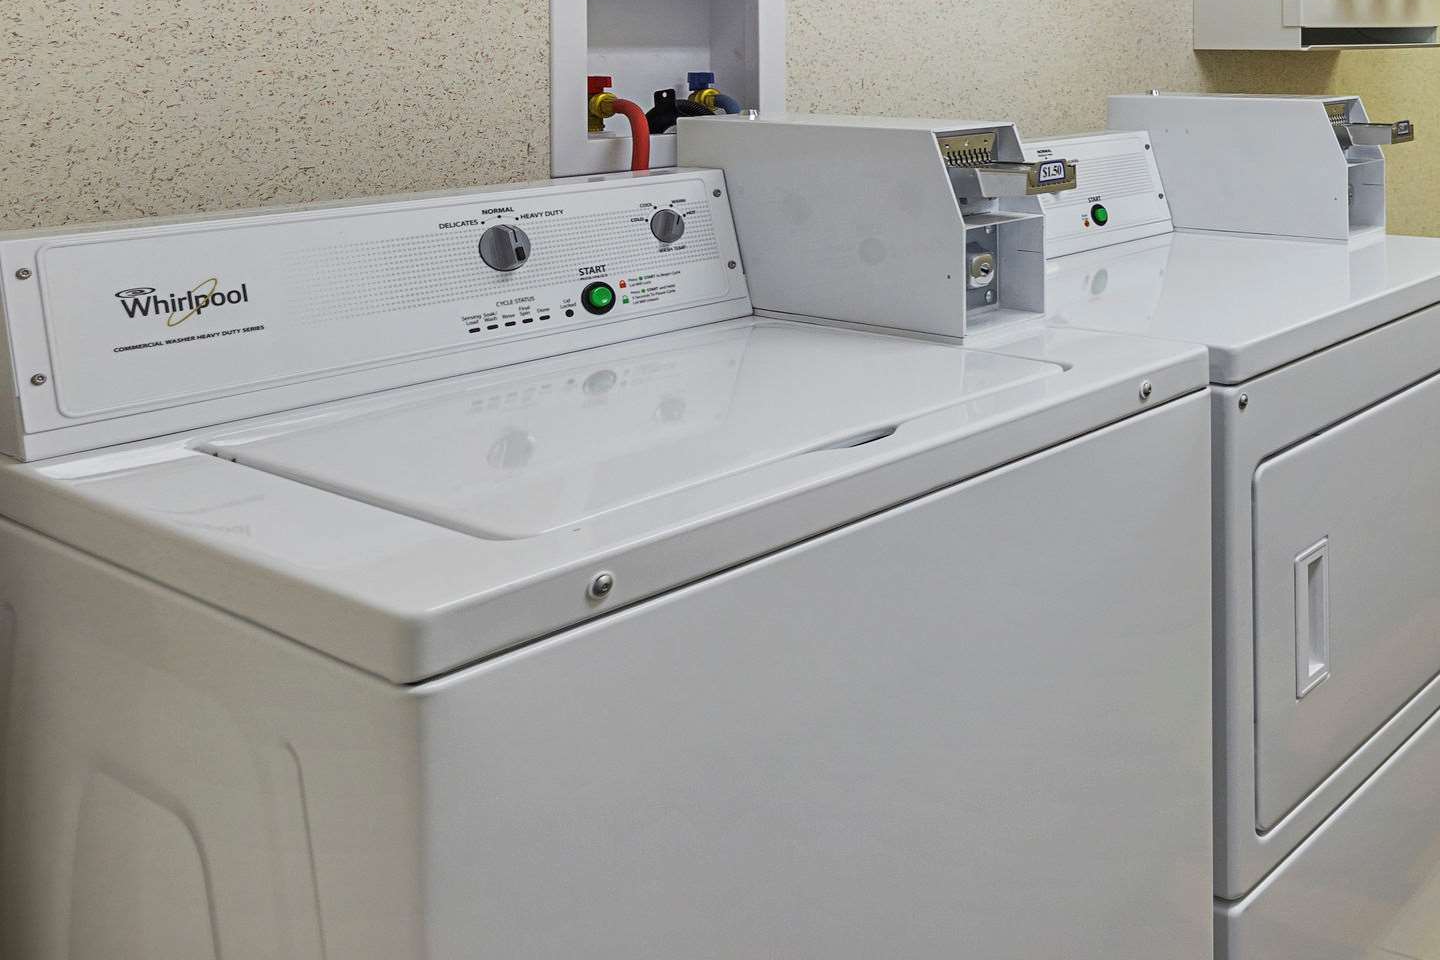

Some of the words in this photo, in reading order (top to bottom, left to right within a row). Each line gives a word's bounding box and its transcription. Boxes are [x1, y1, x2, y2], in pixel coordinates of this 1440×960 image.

[1042, 165, 1062, 178] $1.50
[1088, 195, 1102, 203] START
[481, 207, 514, 215] NORMAL
[520, 212, 544, 220] HEAVY
[545, 209, 564, 217] DUTY
[438, 219, 479, 229] DELICATES
[578, 264, 606, 276] START
[121, 283, 249, 318] Whirlpool
[496, 299, 513, 307] CYCLE
[514, 296, 535, 304] STATUS
[113, 341, 164, 353] COMMERCIAL
[165, 335, 196, 345] WASHER
[196, 331, 221, 340] HEAVY
[221, 328, 242, 337] DUTY
[242, 325, 265, 333] SERIES
